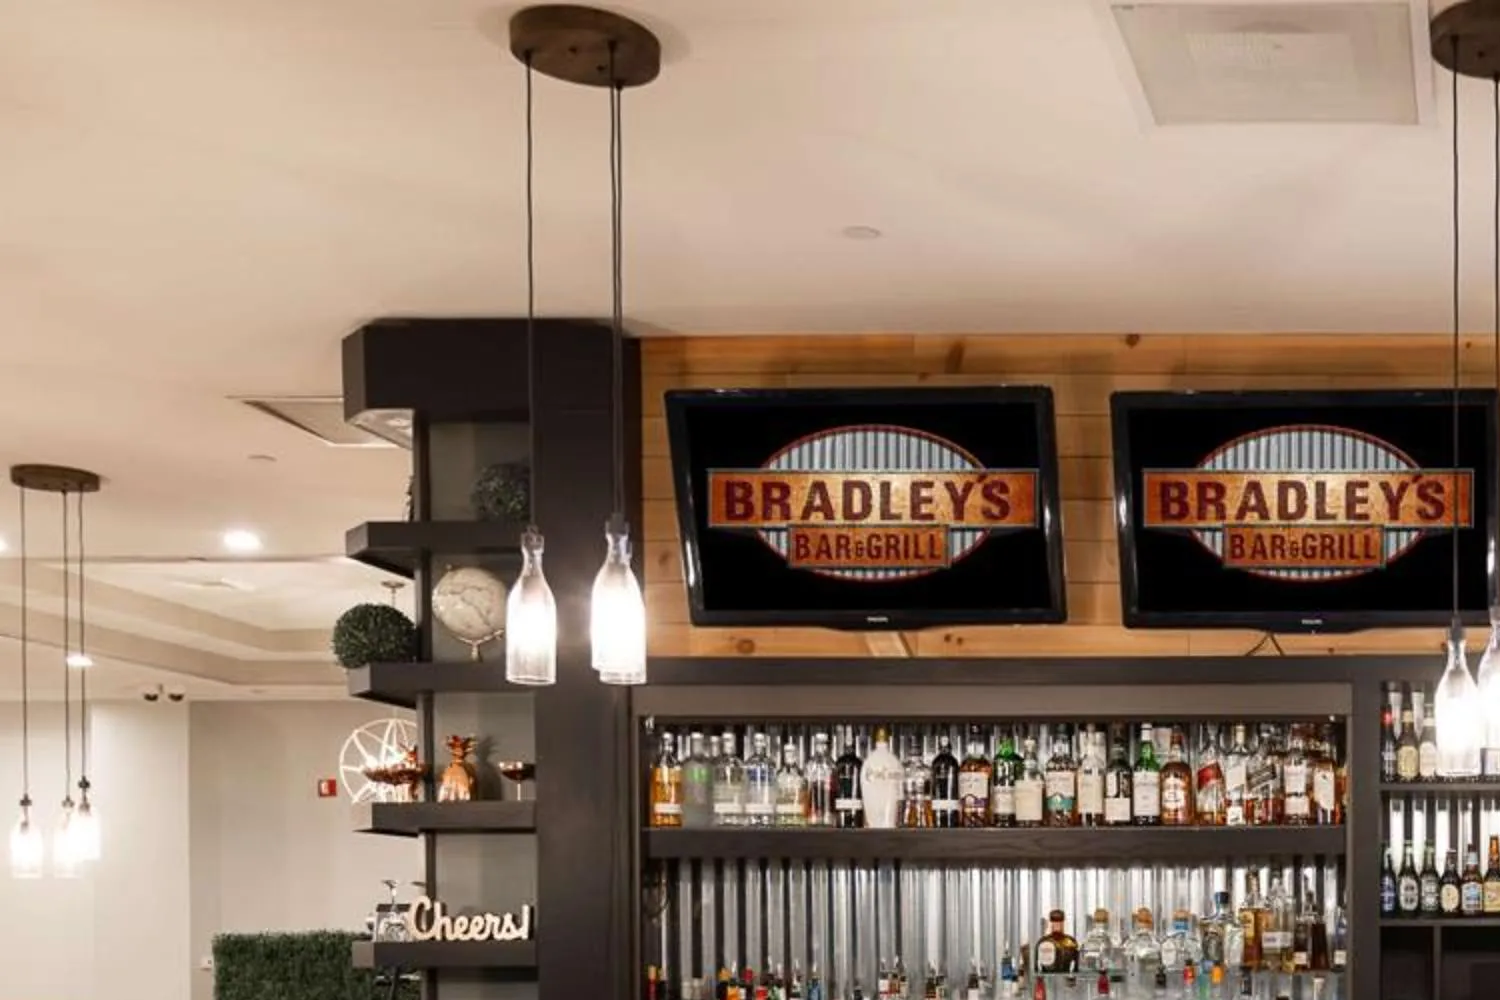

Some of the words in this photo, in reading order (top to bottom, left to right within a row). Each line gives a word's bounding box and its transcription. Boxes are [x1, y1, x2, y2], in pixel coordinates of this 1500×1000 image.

[724, 474, 1010, 522] BRADLEY'S
[1159, 474, 1445, 522] BRADLEY'S
[408, 895, 530, 941] Cheers!
